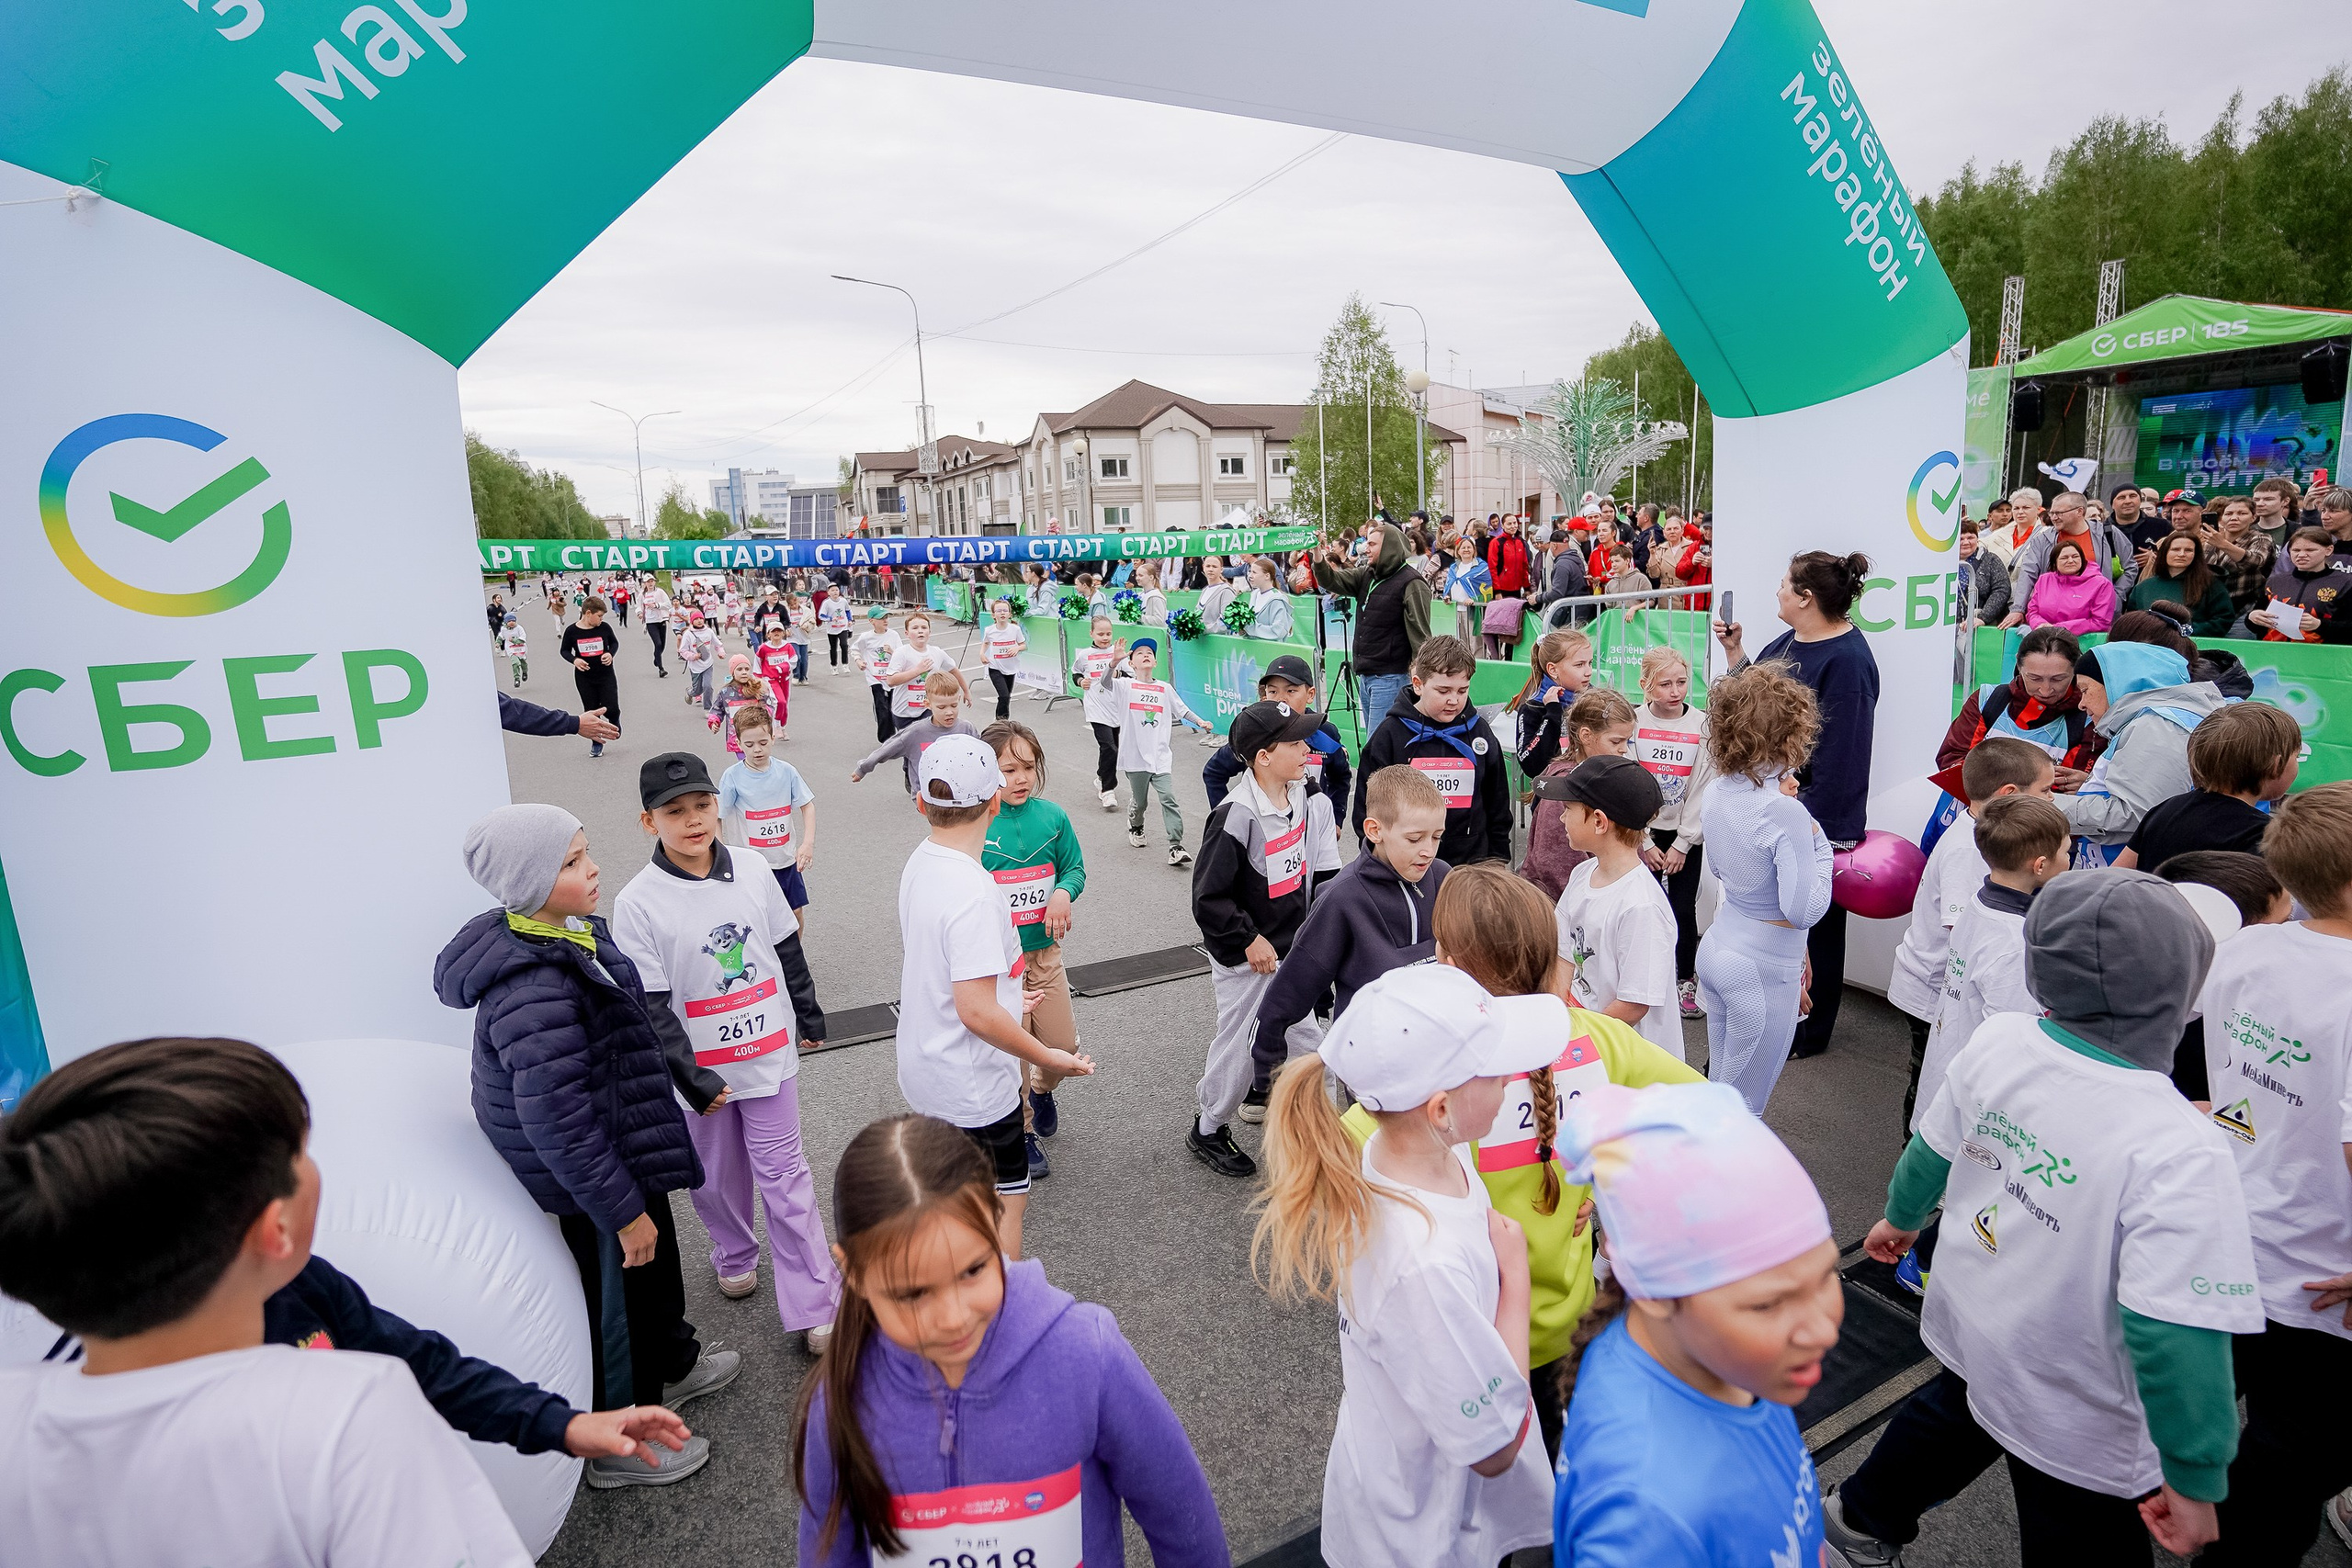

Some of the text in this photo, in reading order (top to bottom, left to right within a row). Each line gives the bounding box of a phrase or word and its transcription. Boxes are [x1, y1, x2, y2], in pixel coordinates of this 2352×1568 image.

[1811, 40, 1927, 266] зелёный
[1780, 71, 1909, 301] марафон
[2122, 319, 2250, 349] СБЕР 185
[1277, 530, 1306, 539] зелёный
[1273, 537, 1305, 547] марафон
[561, 546, 670, 570] СТАРТ
[694, 545, 794, 568] СТАРТ
[815, 543, 907, 566] СТАРТ
[926, 540, 1011, 562] СТАРТ
[1028, 537, 1104, 559] СТАРТ
[1121, 535, 1191, 557] СТАРТ
[1204, 531, 1269, 553] СТАРТ
[1140, 694, 1159, 704] 2720
[1204, 683, 1242, 701] В твоём
[0, 649, 429, 777] СБЕР
[1652, 748, 1683, 761] 2810
[1657, 764, 1674, 773] 400м
[1431, 779, 1460, 792] 809
[760, 823, 786, 836] 2618
[1010, 888, 1046, 908] 2962
[1020, 912, 1039, 921] 400м
[718, 1013, 765, 1043] 2617
[734, 1044, 761, 1057] 400м
[2215, 1282, 2255, 1296] СБЕР
[917, 1506, 947, 1521] СБЕР
